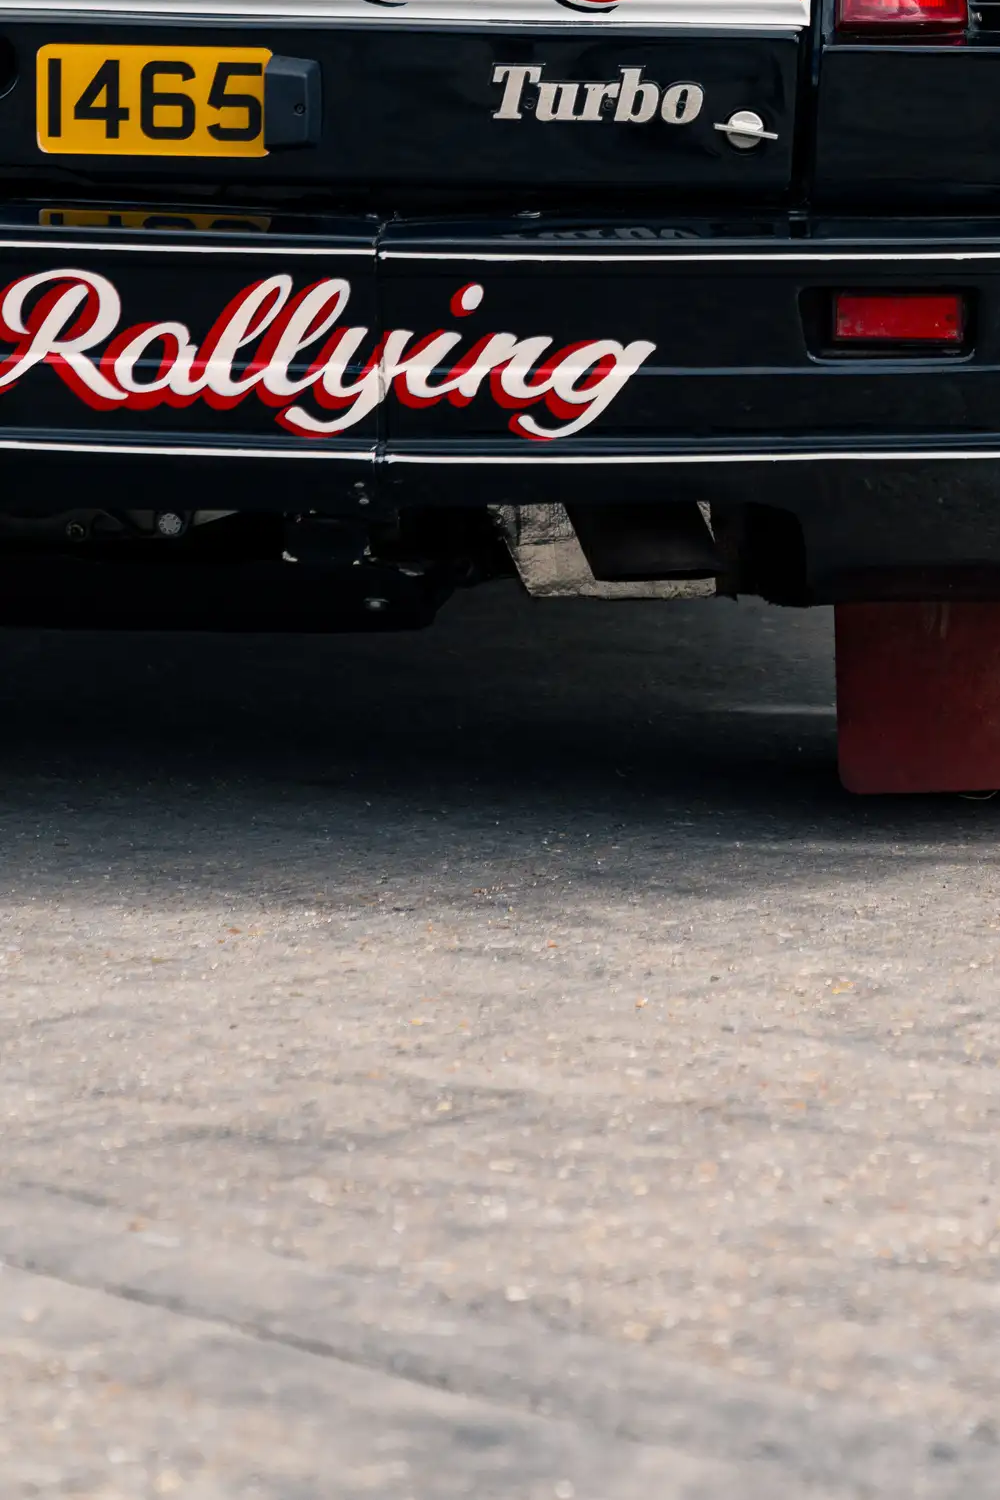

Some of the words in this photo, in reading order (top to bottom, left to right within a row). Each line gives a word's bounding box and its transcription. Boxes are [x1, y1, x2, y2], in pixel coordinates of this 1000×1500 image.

[47, 57, 263, 142] 1465
[489, 62, 705, 124] Turbo
[0, 268, 656, 441] Rallying
